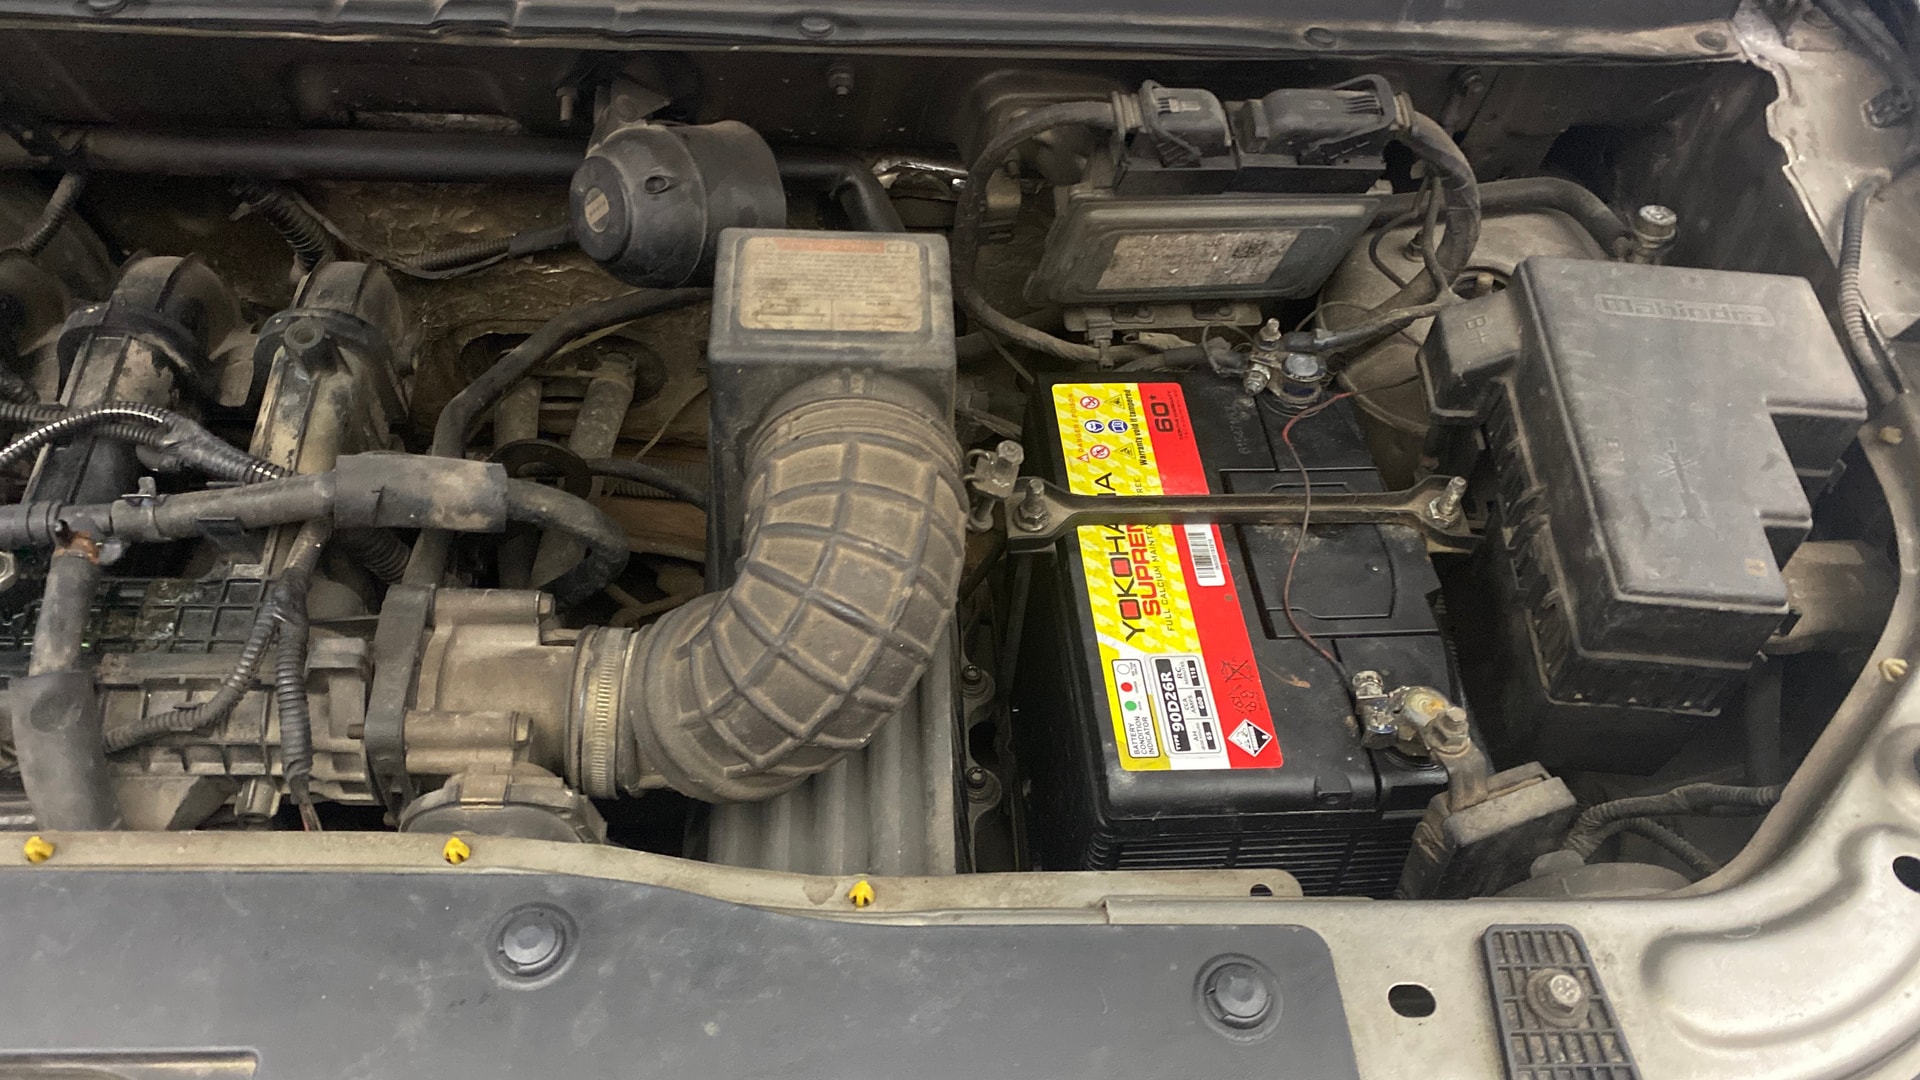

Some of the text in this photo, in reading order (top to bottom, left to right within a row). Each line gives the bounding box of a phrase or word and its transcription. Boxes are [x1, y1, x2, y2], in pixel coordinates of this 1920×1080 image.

[1068, 393, 1077, 417] POISON
[1123, 389, 1136, 417] tampered
[1074, 424, 1084, 452] DANGER
[1135, 437, 1148, 466] Warranty
[1134, 478, 1175, 631] FULL CALCIUM MAINTEN REE
[1126, 524, 1162, 616] SUPRE
[1175, 666, 1184, 679] RC
[1160, 671, 1184, 731] 90D26R
[1188, 695, 1196, 714] AMPS
[1129, 723, 1140, 754] BATTERY
[1134, 716, 1147, 754] CONDITION
[1142, 716, 1155, 755] INDICATOR
[1193, 730, 1199, 741] AH
